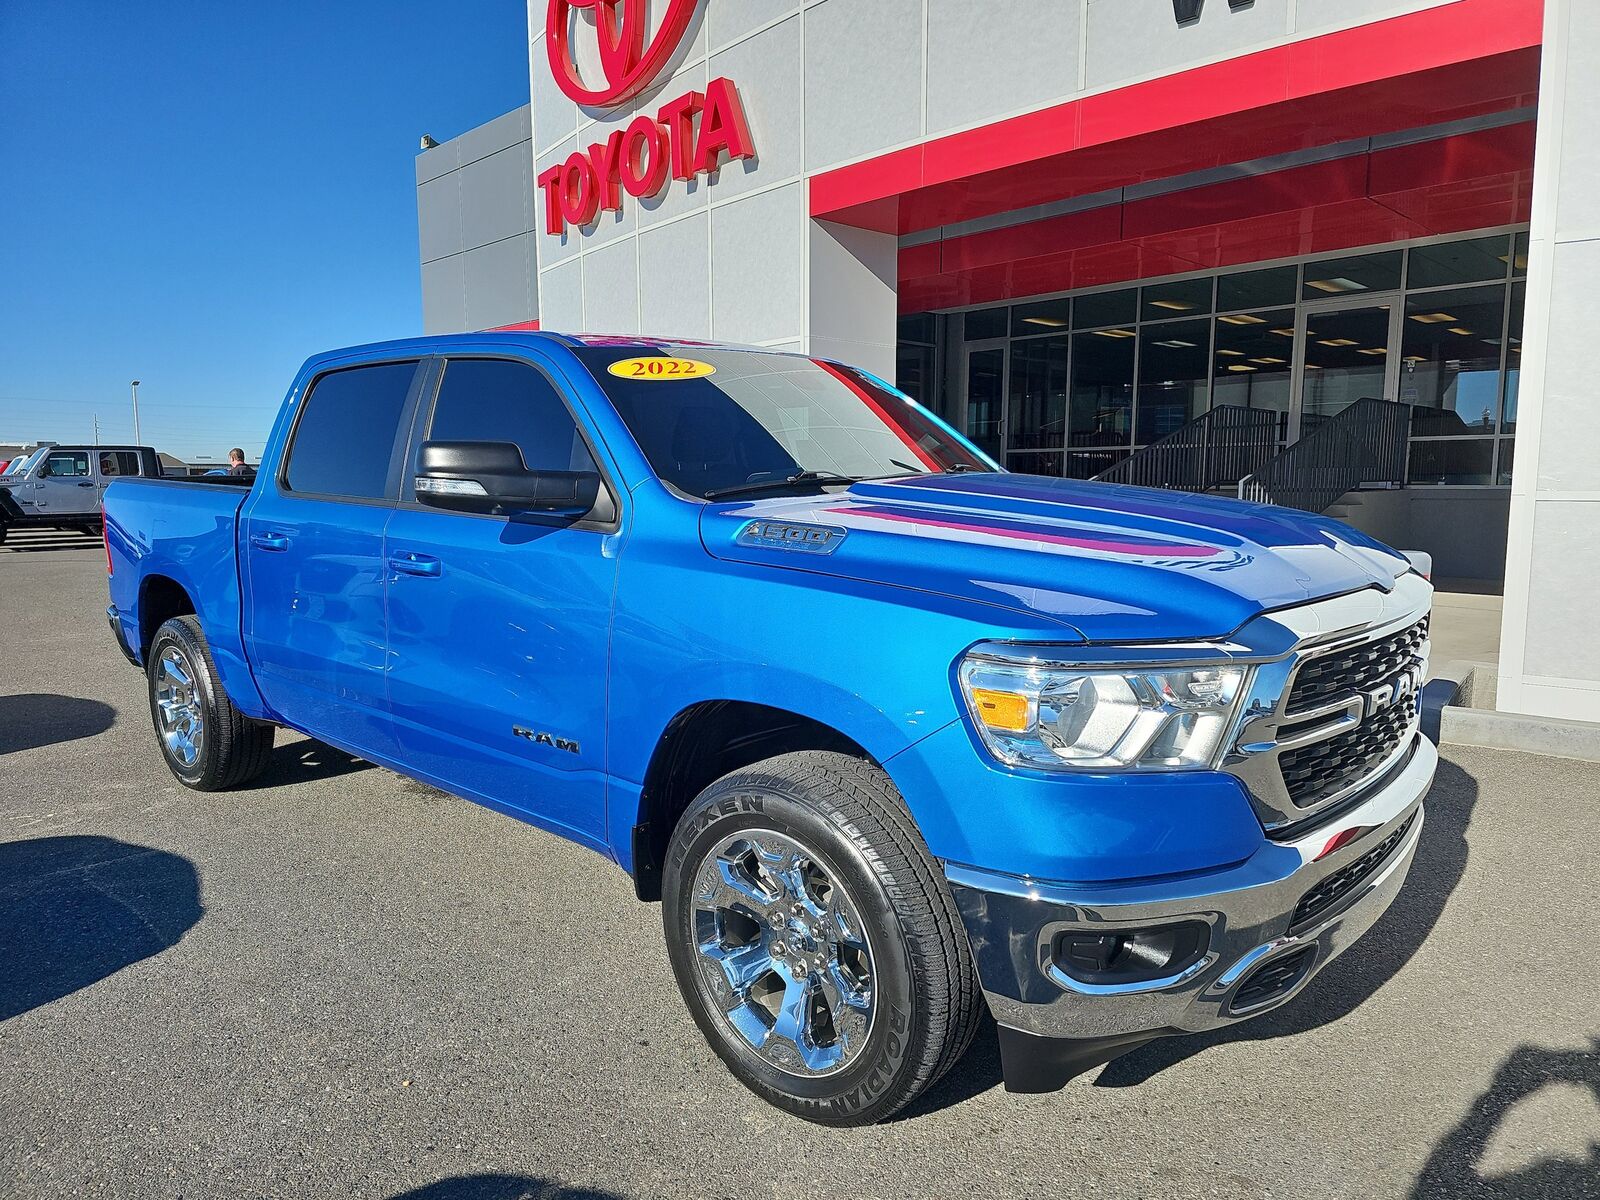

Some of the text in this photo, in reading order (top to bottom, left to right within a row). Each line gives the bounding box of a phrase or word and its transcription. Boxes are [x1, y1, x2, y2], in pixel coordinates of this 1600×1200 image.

[537, 76, 755, 236] TOYOTA
[631, 361, 696, 376] 2022
[748, 523, 833, 544] 1500
[1364, 656, 1423, 718] RAM
[512, 724, 581, 755] RAM
[830, 1001, 907, 1115] ROADIAN
